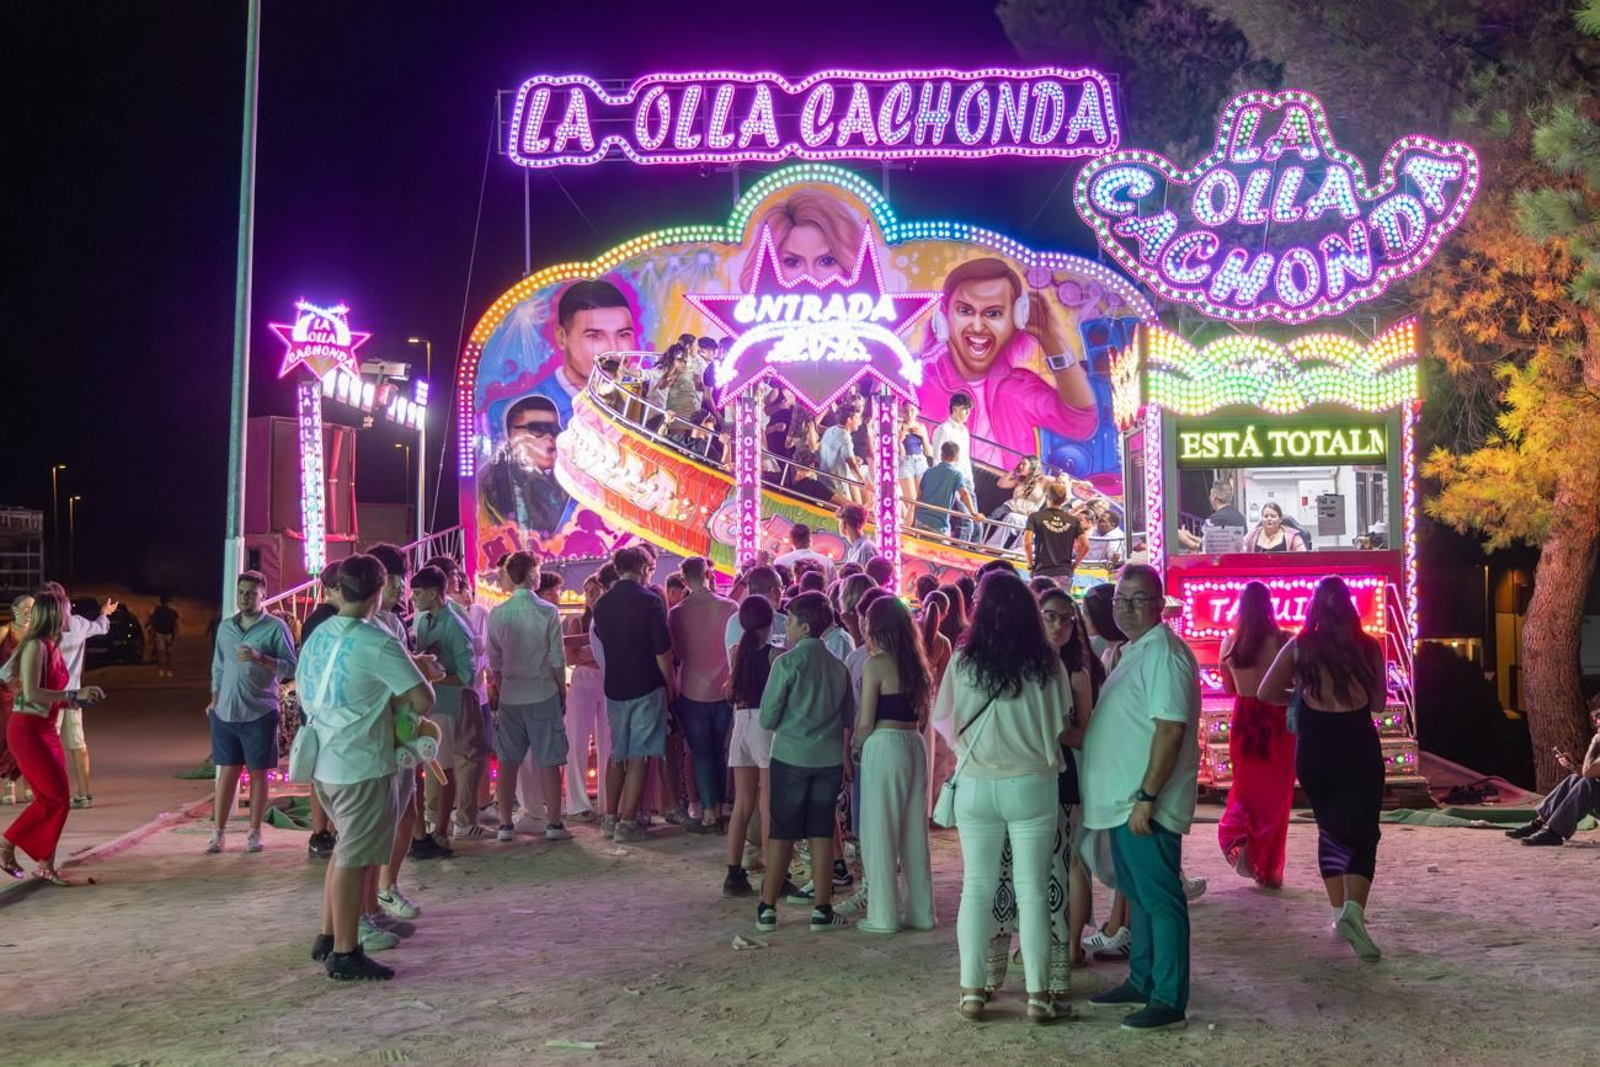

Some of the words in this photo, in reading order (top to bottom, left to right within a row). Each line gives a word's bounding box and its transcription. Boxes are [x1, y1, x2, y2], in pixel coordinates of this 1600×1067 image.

[522, 87, 594, 153] LA
[634, 83, 780, 152] OLLA
[799, 80, 1108, 149] CACHONDA
[1230, 105, 1320, 164] LA
[1191, 164, 1361, 226] OLLA
[1090, 155, 1463, 307] CACHONDA
[314, 318, 331, 331] LA
[734, 293, 897, 323] ENTRADA
[308, 331, 337, 345] OLLA
[288, 344, 355, 369] CACHONDA
[744, 403, 753, 424] LA
[881, 403, 891, 423] LA
[881, 434, 892, 482] OLLA
[1180, 425, 1263, 458] ESTÁ
[743, 438, 754, 483] OLLA
